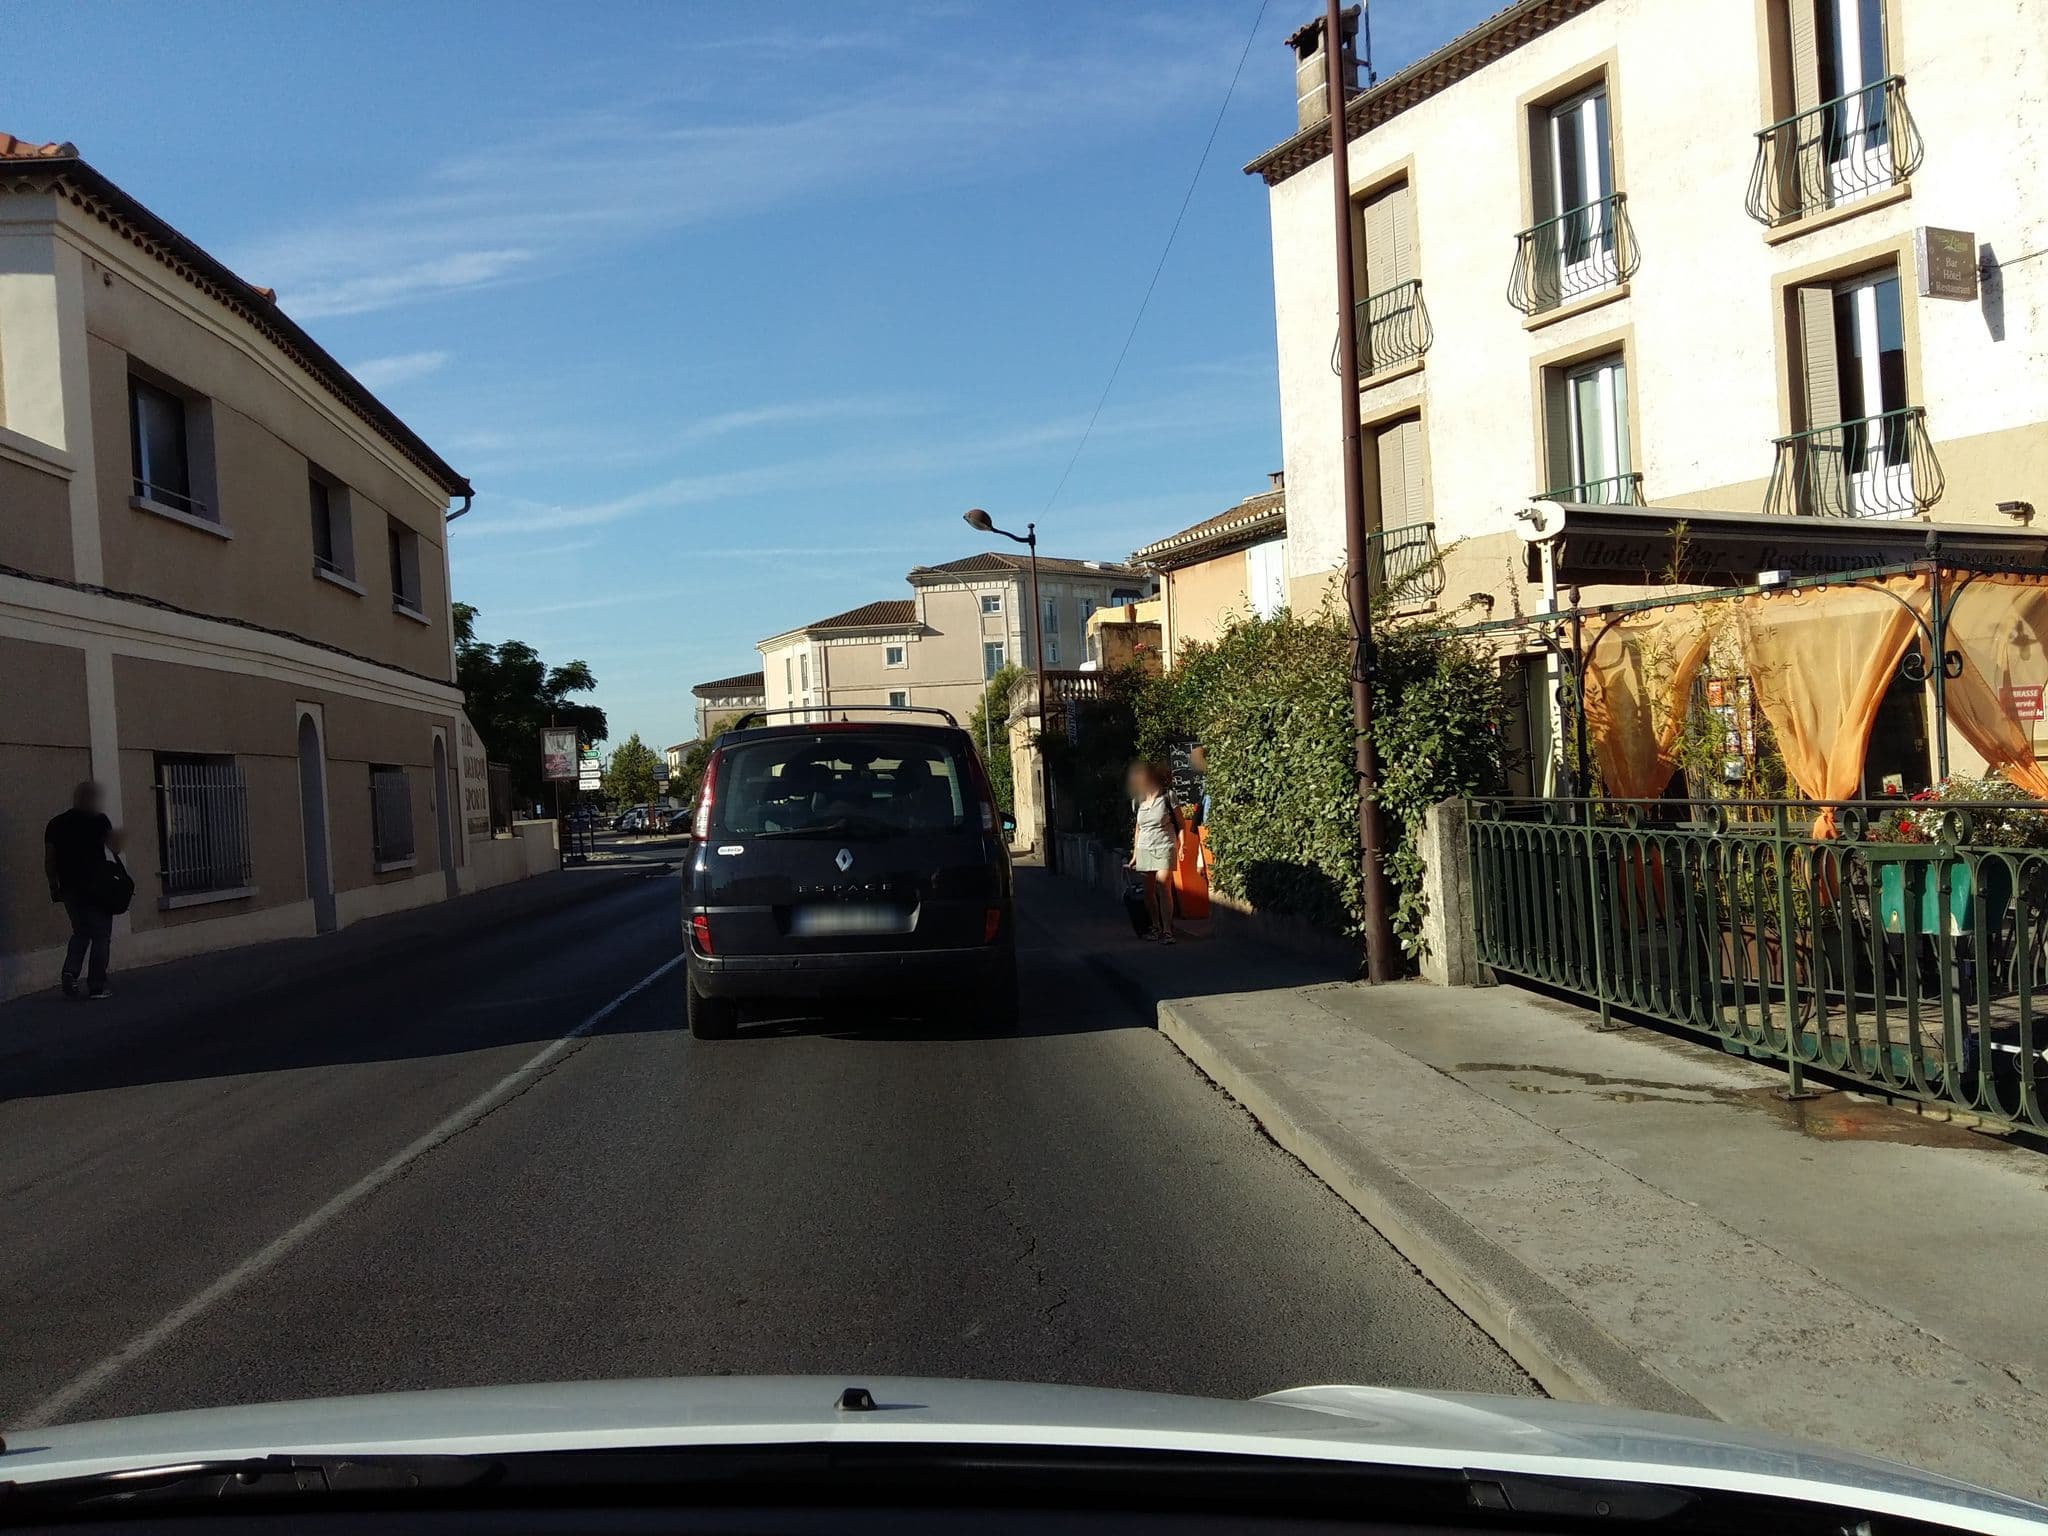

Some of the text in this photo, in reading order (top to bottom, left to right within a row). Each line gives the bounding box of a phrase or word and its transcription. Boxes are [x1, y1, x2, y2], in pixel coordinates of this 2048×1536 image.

[1945, 256, 1957, 268] Bar
[1582, 541, 1650, 566] Hotel
[1760, 546, 1885, 572] Restaurant
[798, 883, 894, 894] ESPACE
